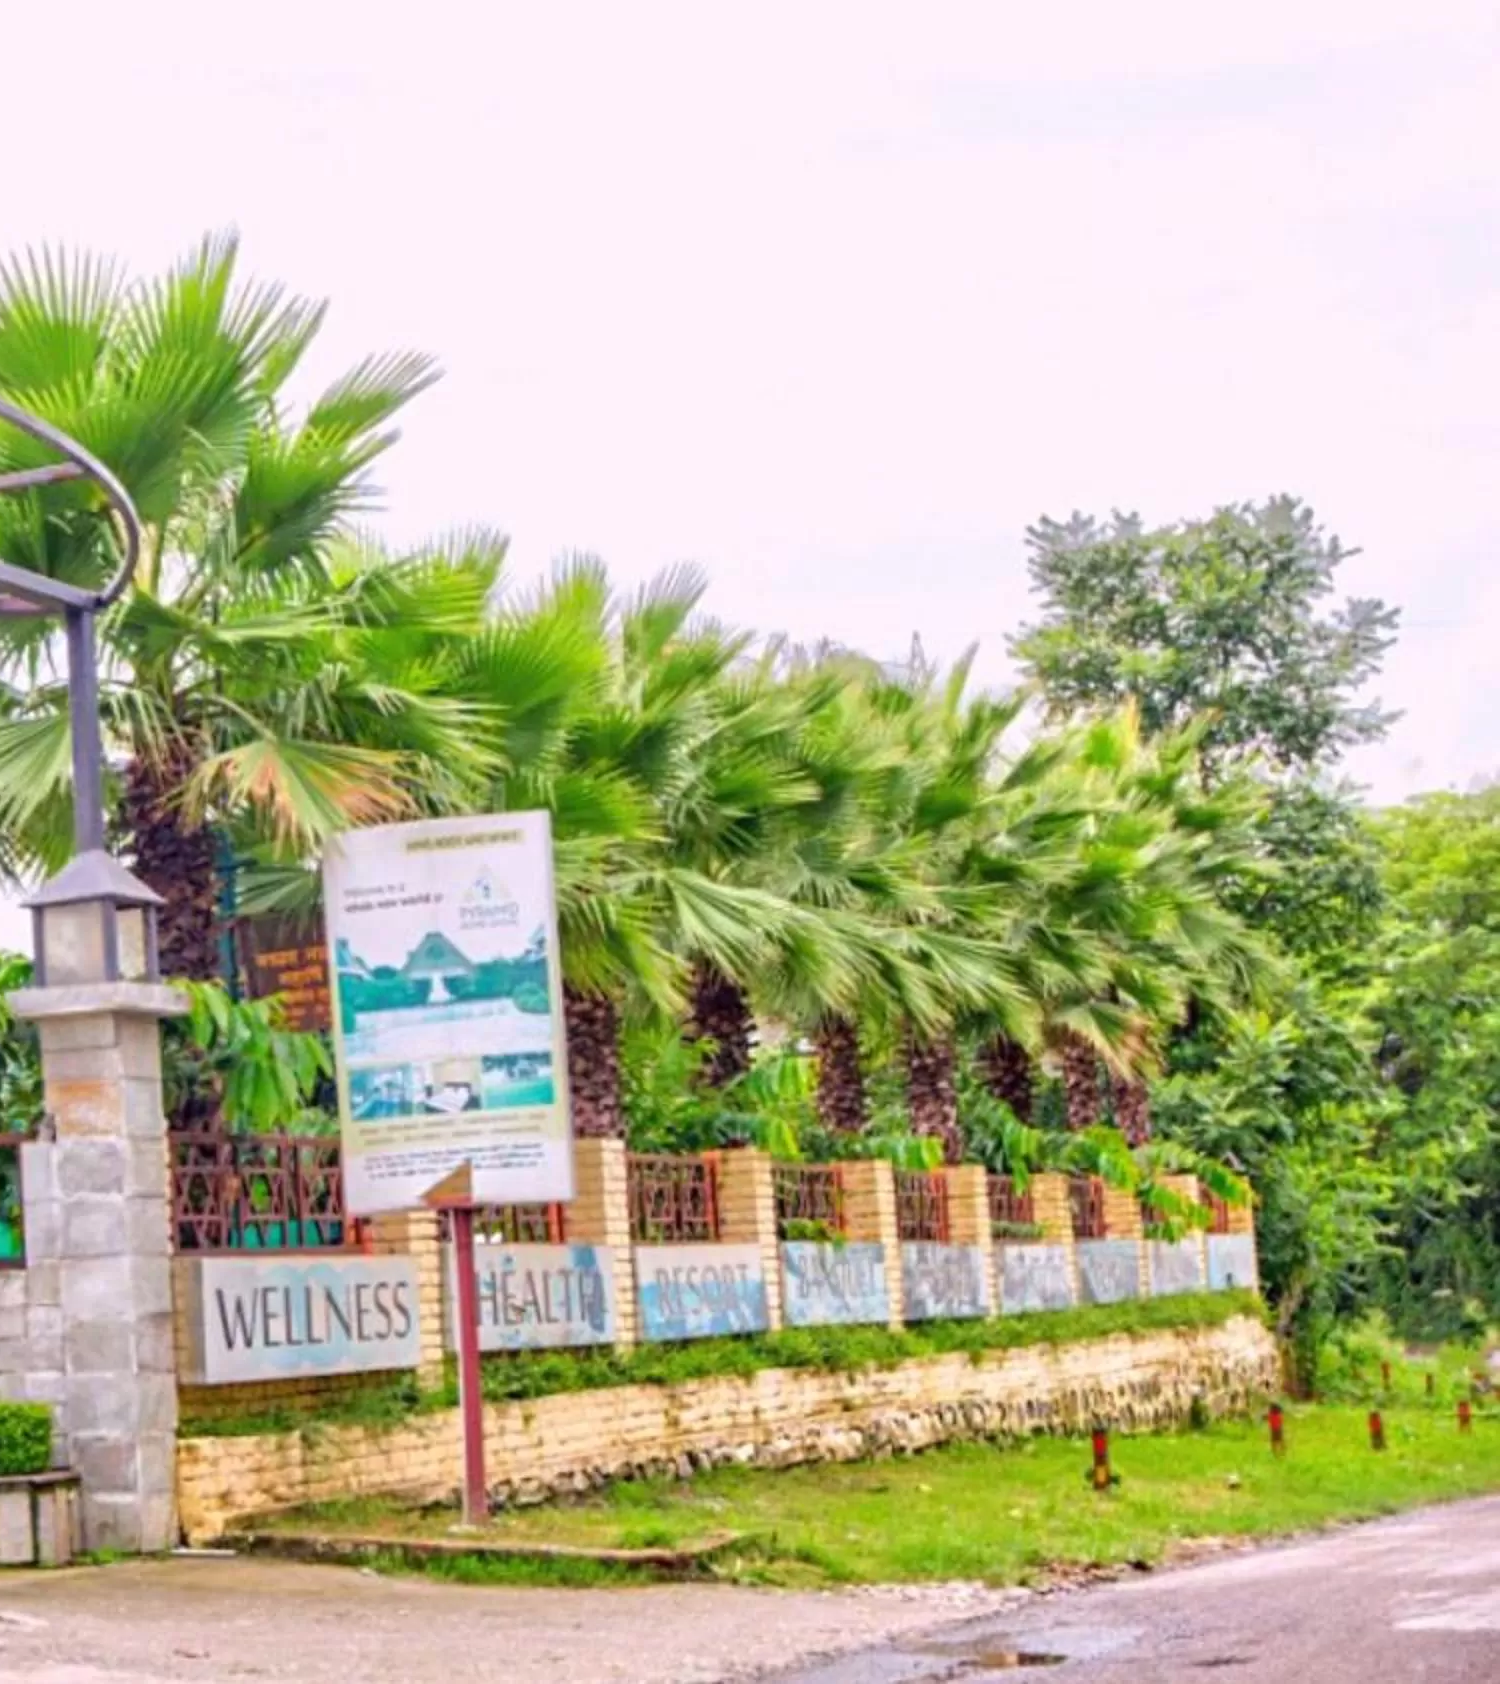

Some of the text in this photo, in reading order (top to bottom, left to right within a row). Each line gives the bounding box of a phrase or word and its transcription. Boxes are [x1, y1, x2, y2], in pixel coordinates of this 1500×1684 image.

[216, 1280, 411, 1351] WELLNESS
[475, 1267, 607, 1328] HEALTH
[655, 1262, 749, 1317] RESORT
